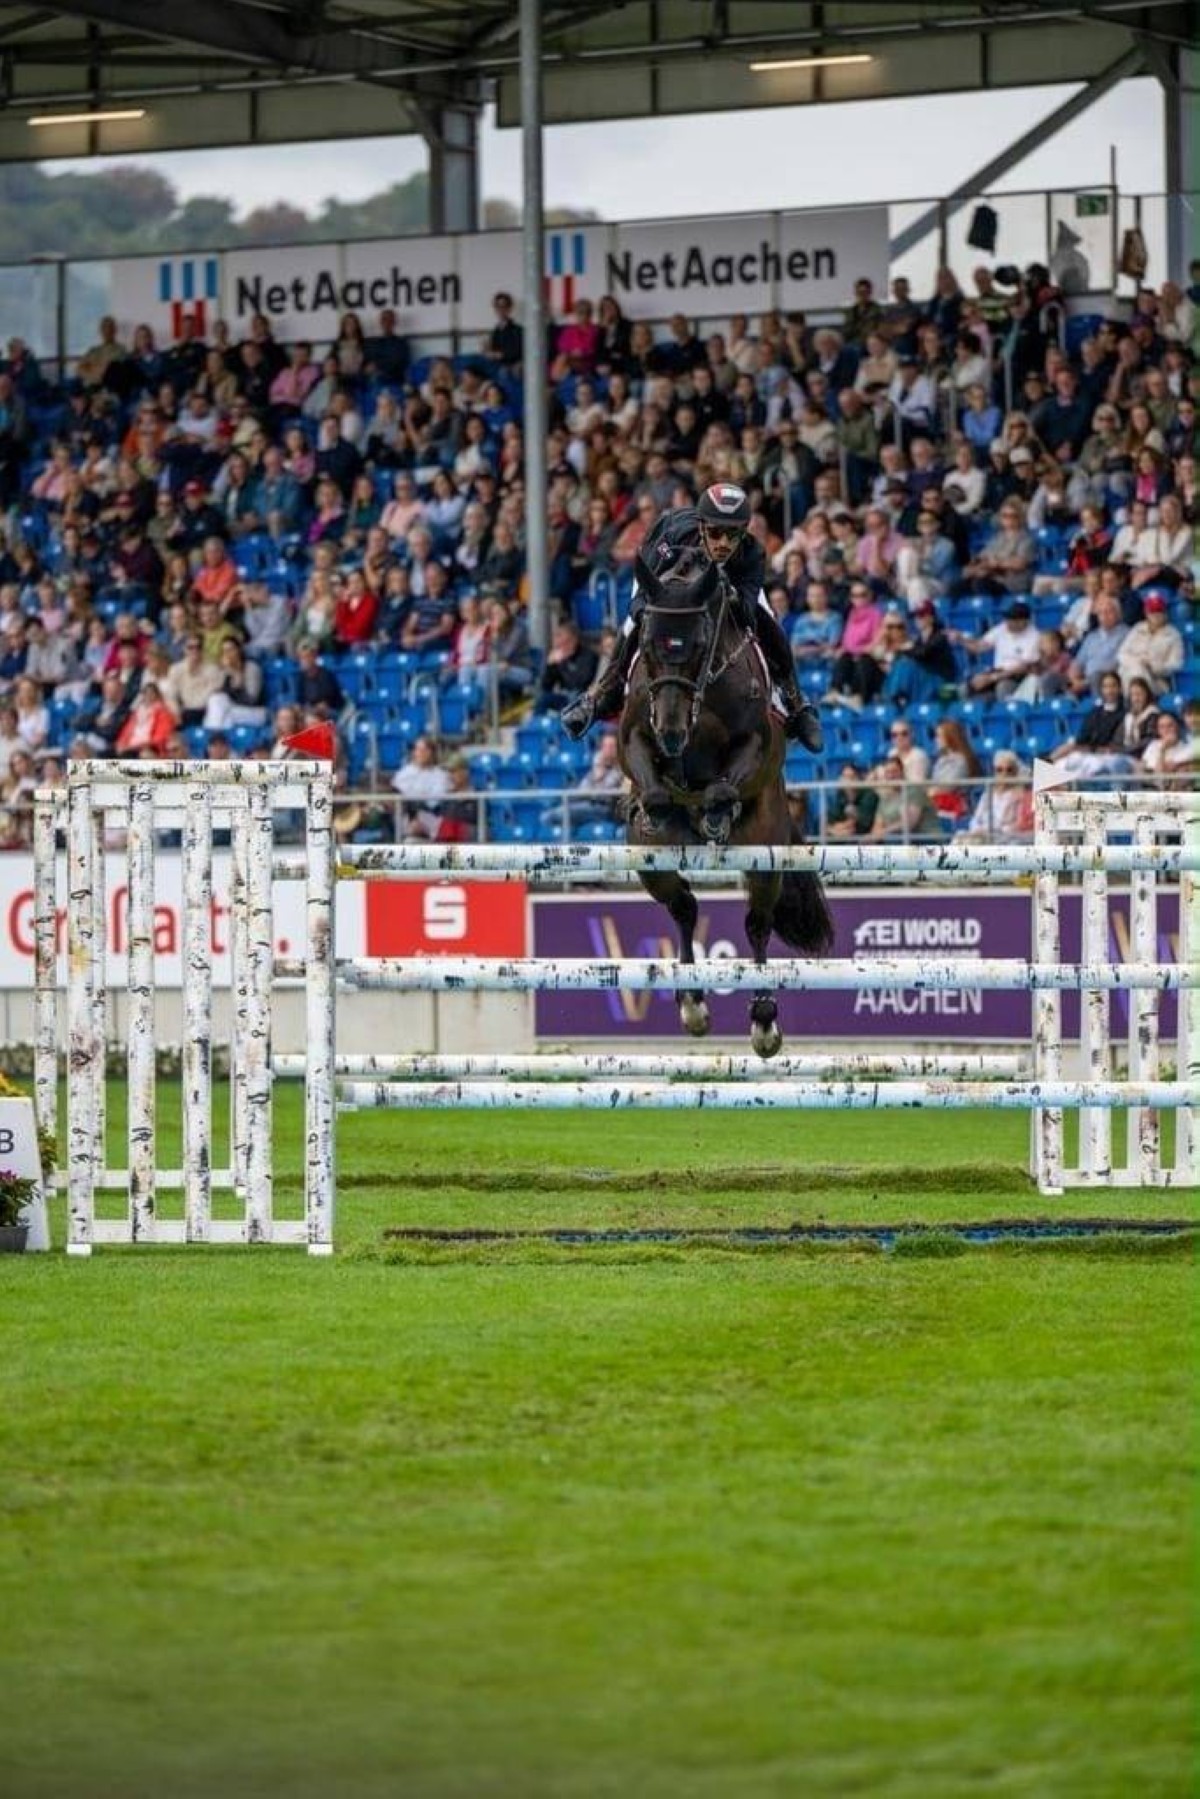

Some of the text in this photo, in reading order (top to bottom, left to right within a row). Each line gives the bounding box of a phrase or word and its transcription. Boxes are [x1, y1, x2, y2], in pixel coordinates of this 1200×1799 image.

[606, 241, 837, 291] NetAachen
[237, 266, 461, 315] NetAachen
[904, 919, 981, 945] WORLD
[853, 985, 981, 1014] AACHEN
